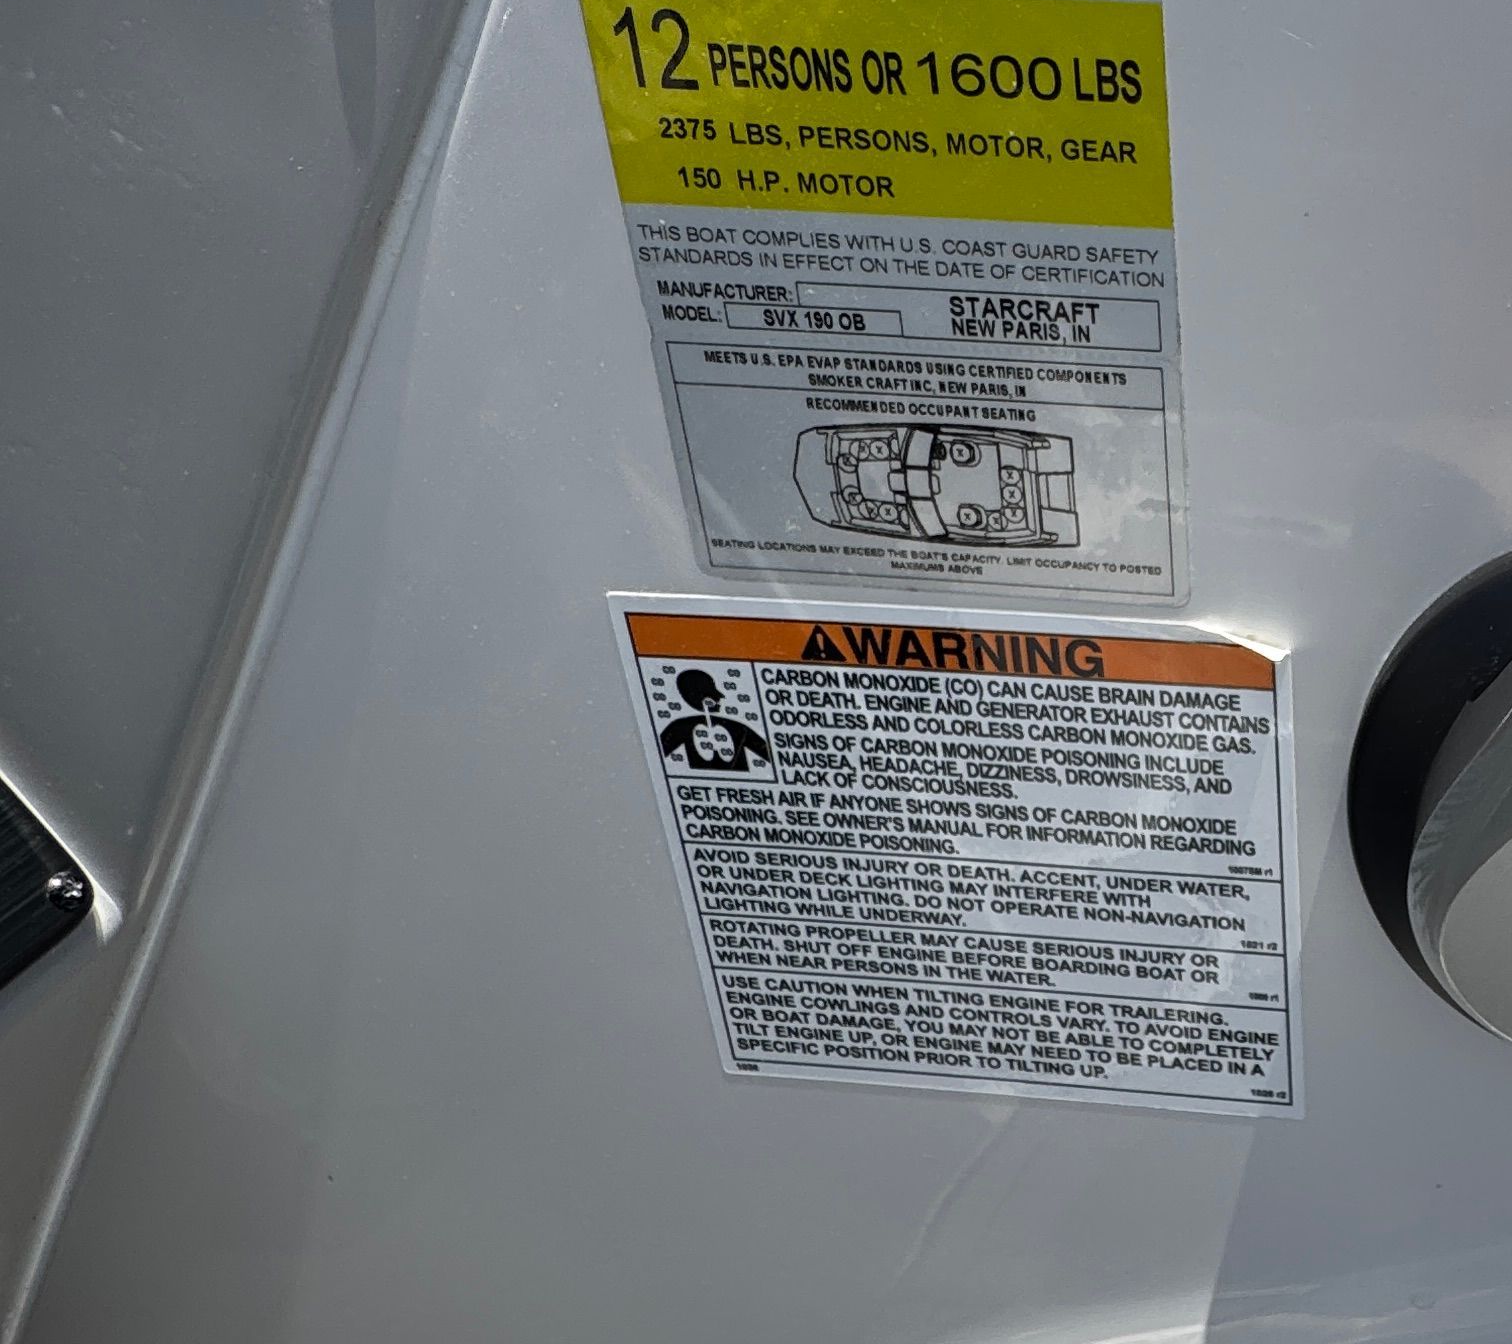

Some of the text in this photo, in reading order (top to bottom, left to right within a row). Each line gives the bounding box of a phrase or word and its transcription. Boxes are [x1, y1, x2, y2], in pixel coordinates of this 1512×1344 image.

[612, 6, 1143, 105] 12 PERSONS OR 1600 LBS
[658, 116, 1138, 164] 2375 LBS, PERSONS, MOTOR, GEAR
[677, 166, 896, 199] 150 H.P. MOTOR
[635, 222, 682, 242] THIS
[685, 225, 737, 244] BOAT
[742, 229, 841, 250] COMPLIES
[843, 234, 895, 252] WITH
[941, 238, 1007, 258] COAST
[1012, 242, 1081, 262] GUARD
[1086, 246, 1159, 265] SAFETY
[638, 246, 1165, 288] STANDARDS IN EFFECT ON THE DATE OF CERTIFICATION
[762, 308, 867, 332] SVX 190 OB
[949, 295, 1100, 325] STARCRAFT
[951, 319, 1091, 346] NEW PARIS, IN
[841, 625, 1105, 679] WARNING
[760, 667, 1242, 712] CARBON MONOXIDE (CO) CAN CAUSE BRAIN DAMAGE
[764, 688, 795, 707] OR
[863, 693, 933, 714] ENGINE
[934, 696, 973, 717] AND
[975, 698, 1088, 724] GENERATOR
[1090, 706, 1175, 729] EXHAUST
[1178, 712, 1271, 735] CONTAINS
[769, 708, 869, 731] ODORLESS
[871, 714, 911, 733] AND
[913, 716, 1025, 741] COLORLESS
[1027, 724, 1107, 746] CARBON
[1110, 729, 1210, 753] MONOXIDE
[773, 731, 1225, 776] SIGNS OF CARBON MONOXIDE POISONING INCLUDE
[1193, 777, 1233, 795] AND
[676, 784, 1237, 836] GET FRESH AIR IF ANYONE SHOWS SIGNS OF CARBON MONOXIDE
[784, 809, 821, 828] SEE
[822, 812, 906, 833] OWNER'S
[907, 816, 984, 838] MANUAL
[985, 822, 1024, 841] FOR
[1025, 825, 1147, 850] INFORMATION
[1149, 834, 1256, 857] REGARDING
[693, 847, 750, 865] AVOID
[754, 851, 839, 870] SERIOUS
[841, 857, 910, 875] INJURY
[913, 861, 944, 878] OR
[1105, 875, 1174, 894] UNDER
[696, 863, 1152, 909] OR UNDER DECK LIGHTING MAY INTERFERE WITH
[699, 880, 813, 901] NAVIGATION
[913, 894, 943, 910] DO
[946, 896, 986, 913] NOT
[990, 899, 1079, 920] OPERATE
[1083, 906, 1246, 933] NON-NAVIGATION
[708, 918, 1220, 969] ROTATING PROPELLER MAY CAUSE SERIOUS INJURY OR
[782, 939, 832, 955] SHUT
[836, 942, 873, 958] OFF
[876, 945, 948, 964] ENGINE
[951, 951, 1027, 970] BEFORE
[1031, 957, 1131, 978] BOARDING
[1135, 965, 1186, 982] BOAT
[1190, 969, 1220, 985] OR
[721, 974, 761, 991] USE
[764, 977, 849, 996] CAUTION
[851, 983, 910, 1001] WHEN
[912, 987, 985, 1007] TILTING
[988, 993, 1061, 1013] ENGINE
[1064, 999, 1105, 1016] FOR
[725, 990, 797, 1009] ENGINE
[800, 995, 901, 1016] COWLINGS
[904, 1003, 945, 1019] AND
[948, 1007, 1053, 1028] CONTROLS
[1113, 1020, 1141, 1035] TO
[1143, 1022, 1203, 1040] AVOID
[1207, 1027, 1280, 1047] ENGINE
